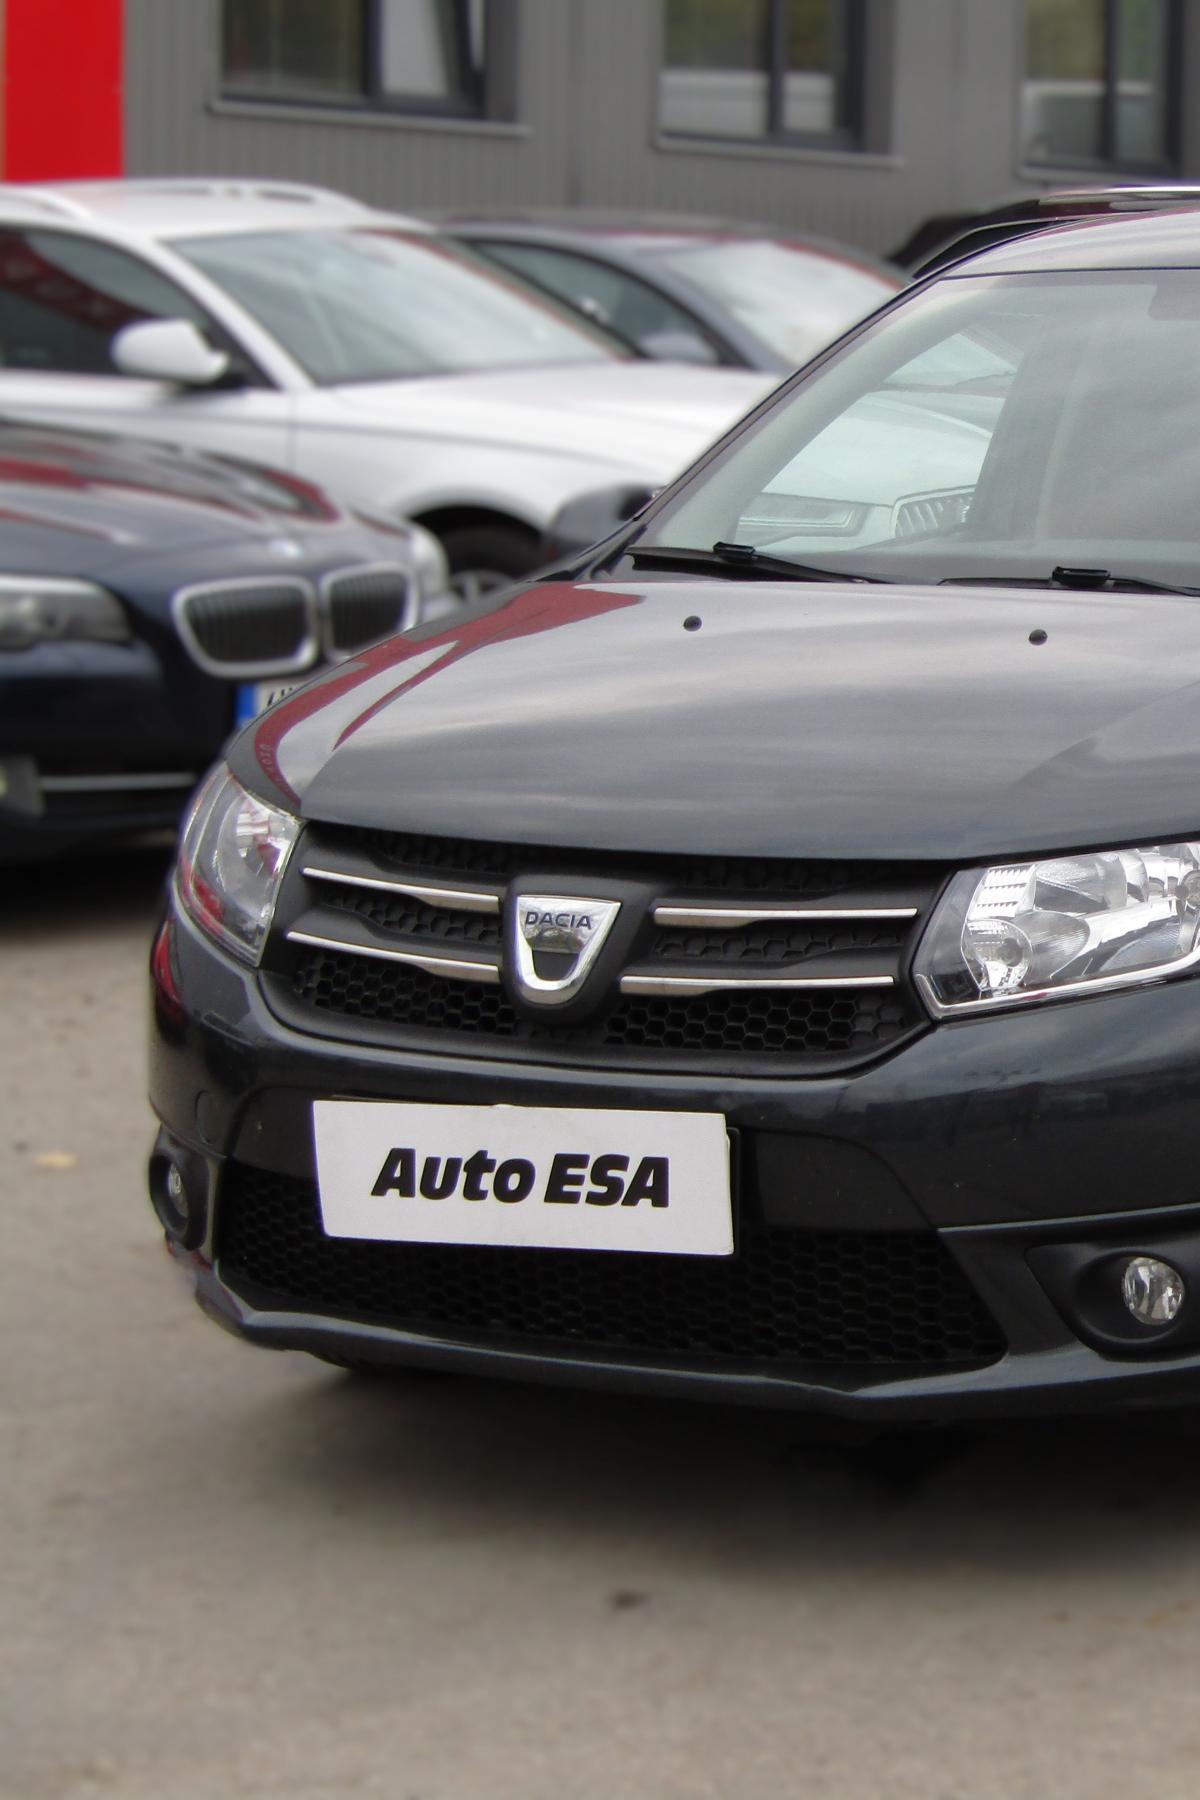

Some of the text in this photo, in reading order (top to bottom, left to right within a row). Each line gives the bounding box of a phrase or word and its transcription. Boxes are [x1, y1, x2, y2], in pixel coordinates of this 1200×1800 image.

[525, 911, 592, 930] DACIA
[371, 1148, 669, 1207] Auto ESA
